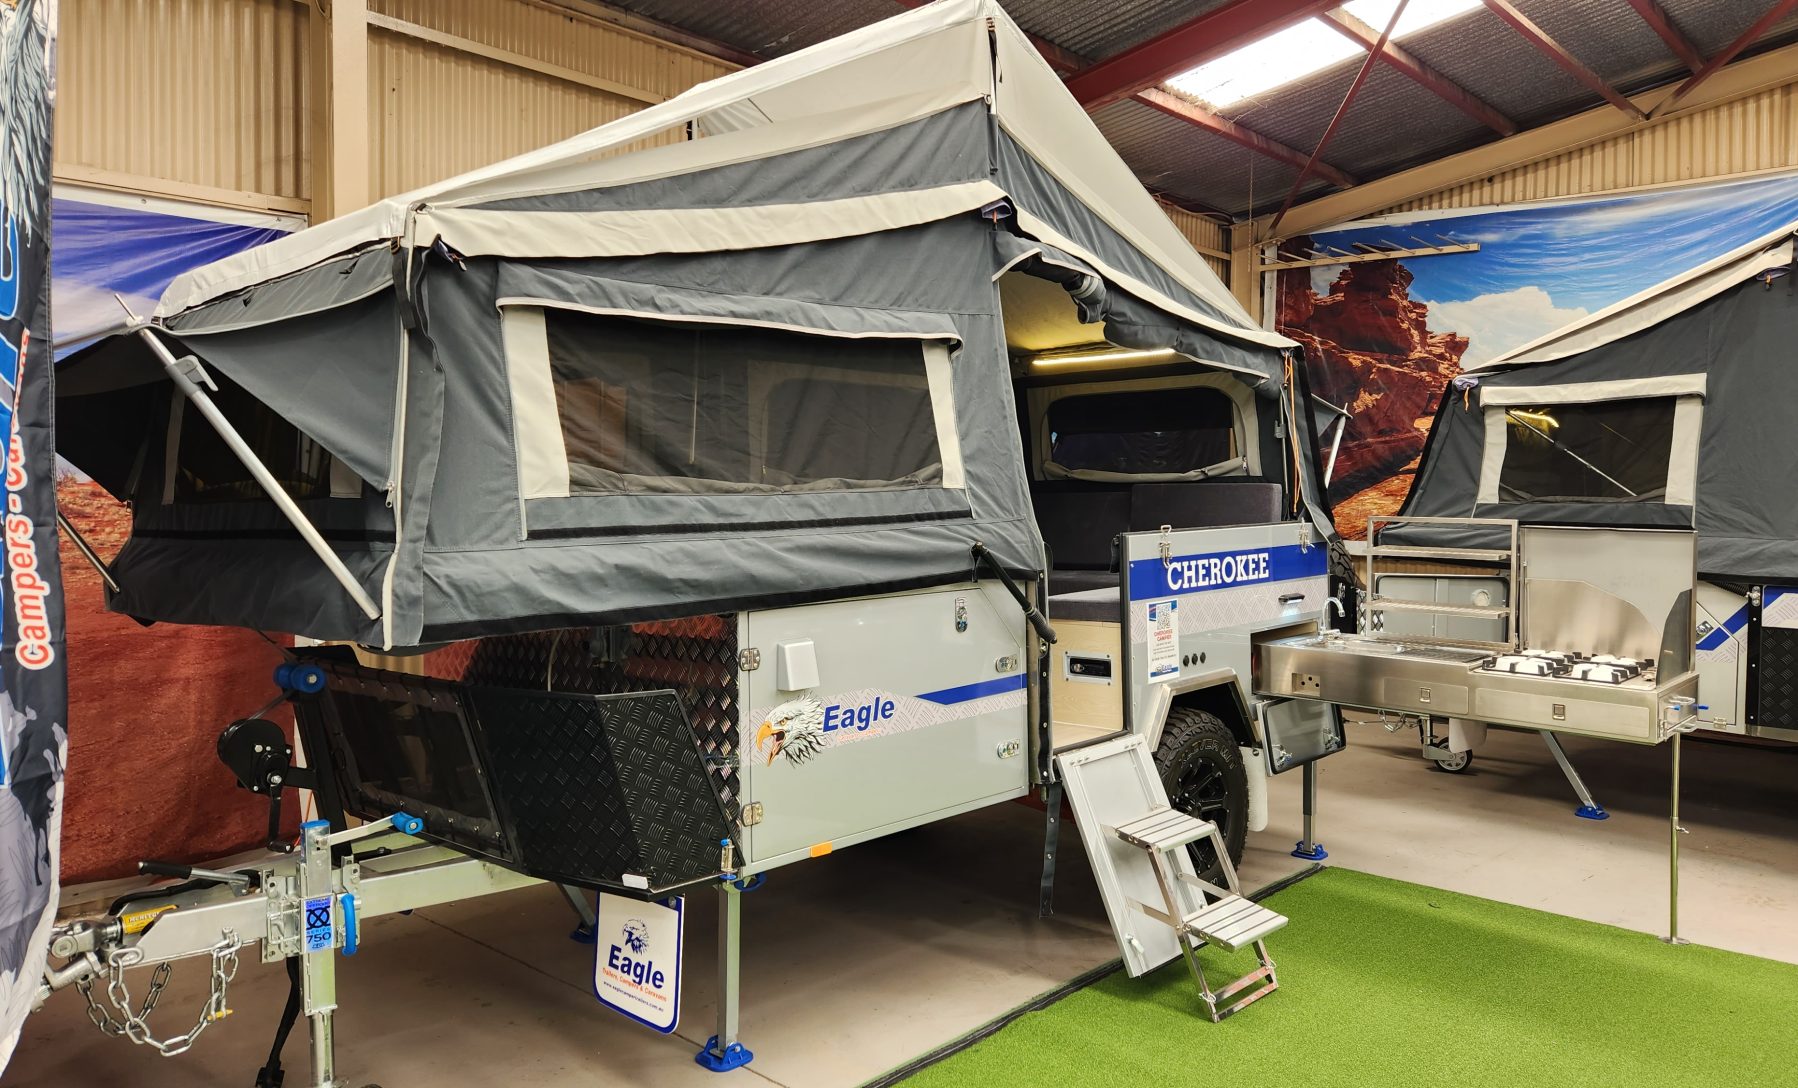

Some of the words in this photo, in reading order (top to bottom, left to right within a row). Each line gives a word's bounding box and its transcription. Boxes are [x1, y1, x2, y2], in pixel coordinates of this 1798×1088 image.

[1167, 553, 1269, 590] CHEROKEE
[8, 518, 50, 665] Campers
[823, 696, 895, 732] Eagle
[306, 932, 331, 944] 750
[608, 944, 665, 989] Eagle
